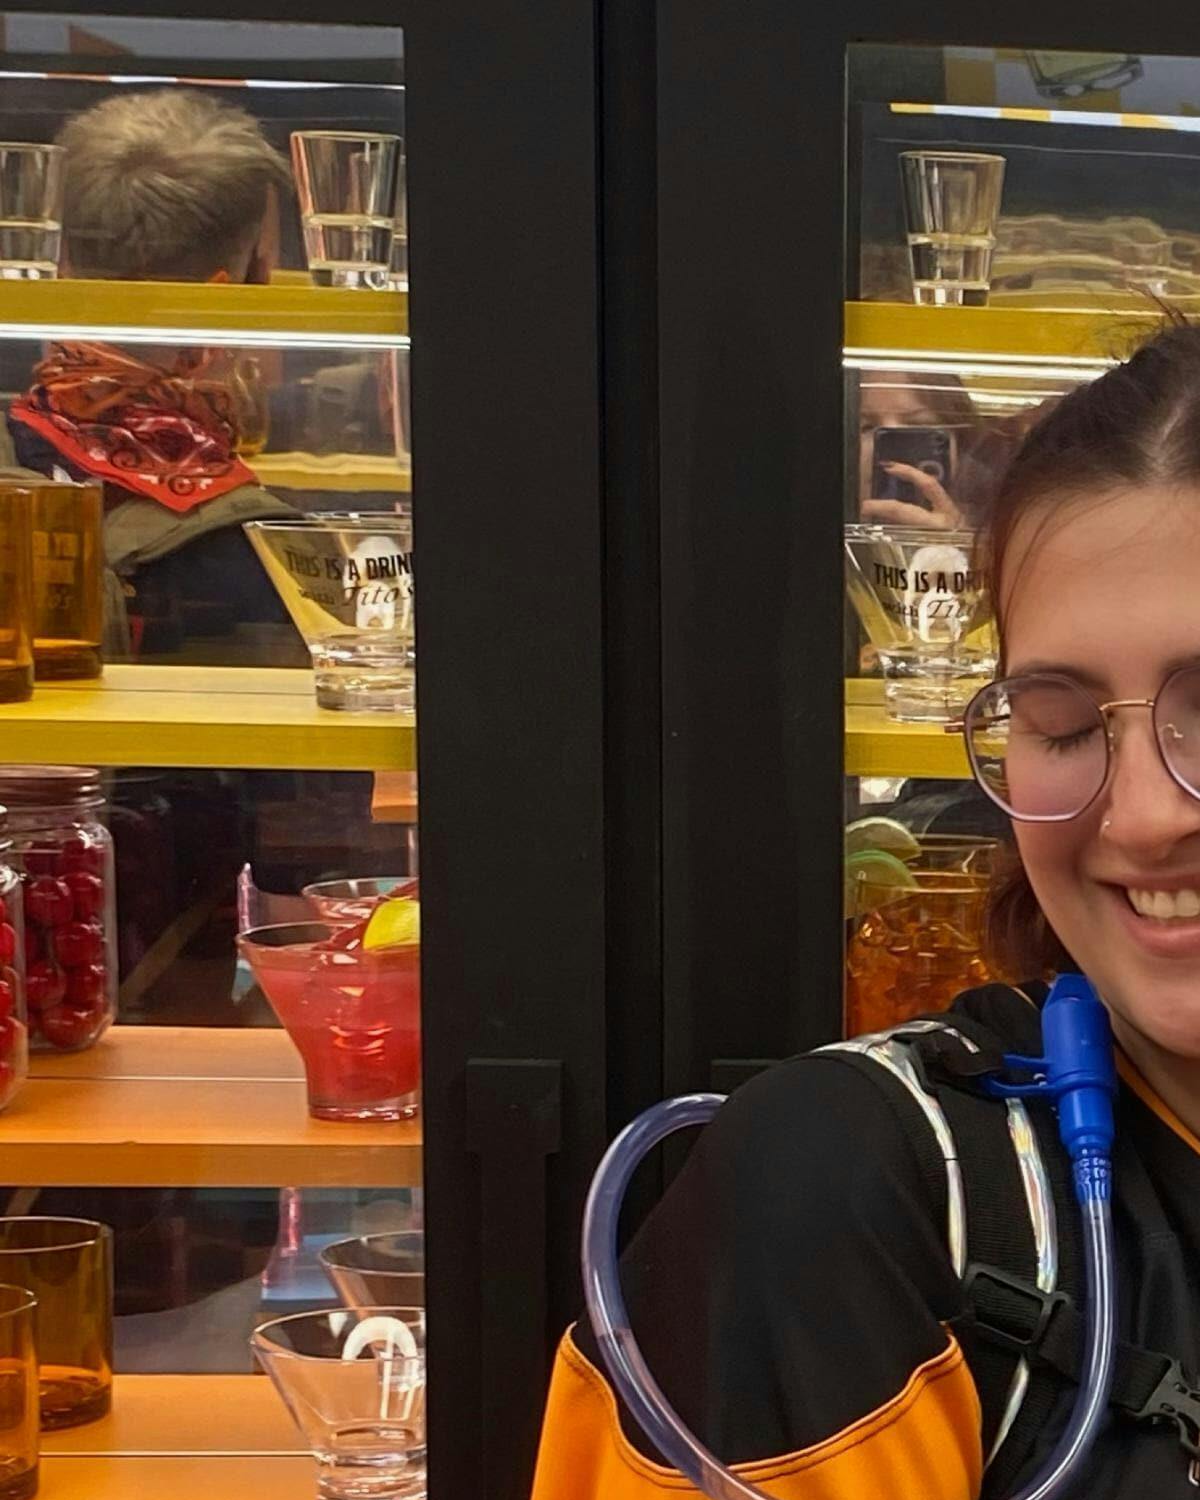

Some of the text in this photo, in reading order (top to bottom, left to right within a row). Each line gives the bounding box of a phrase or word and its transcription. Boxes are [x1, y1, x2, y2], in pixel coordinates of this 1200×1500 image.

[284, 549, 320, 577] THIS
[325, 557, 341, 580] IS
[348, 558, 361, 581] A
[873, 562, 909, 590] THIS
[915, 570, 930, 593] IS
[936, 571, 947, 594] A
